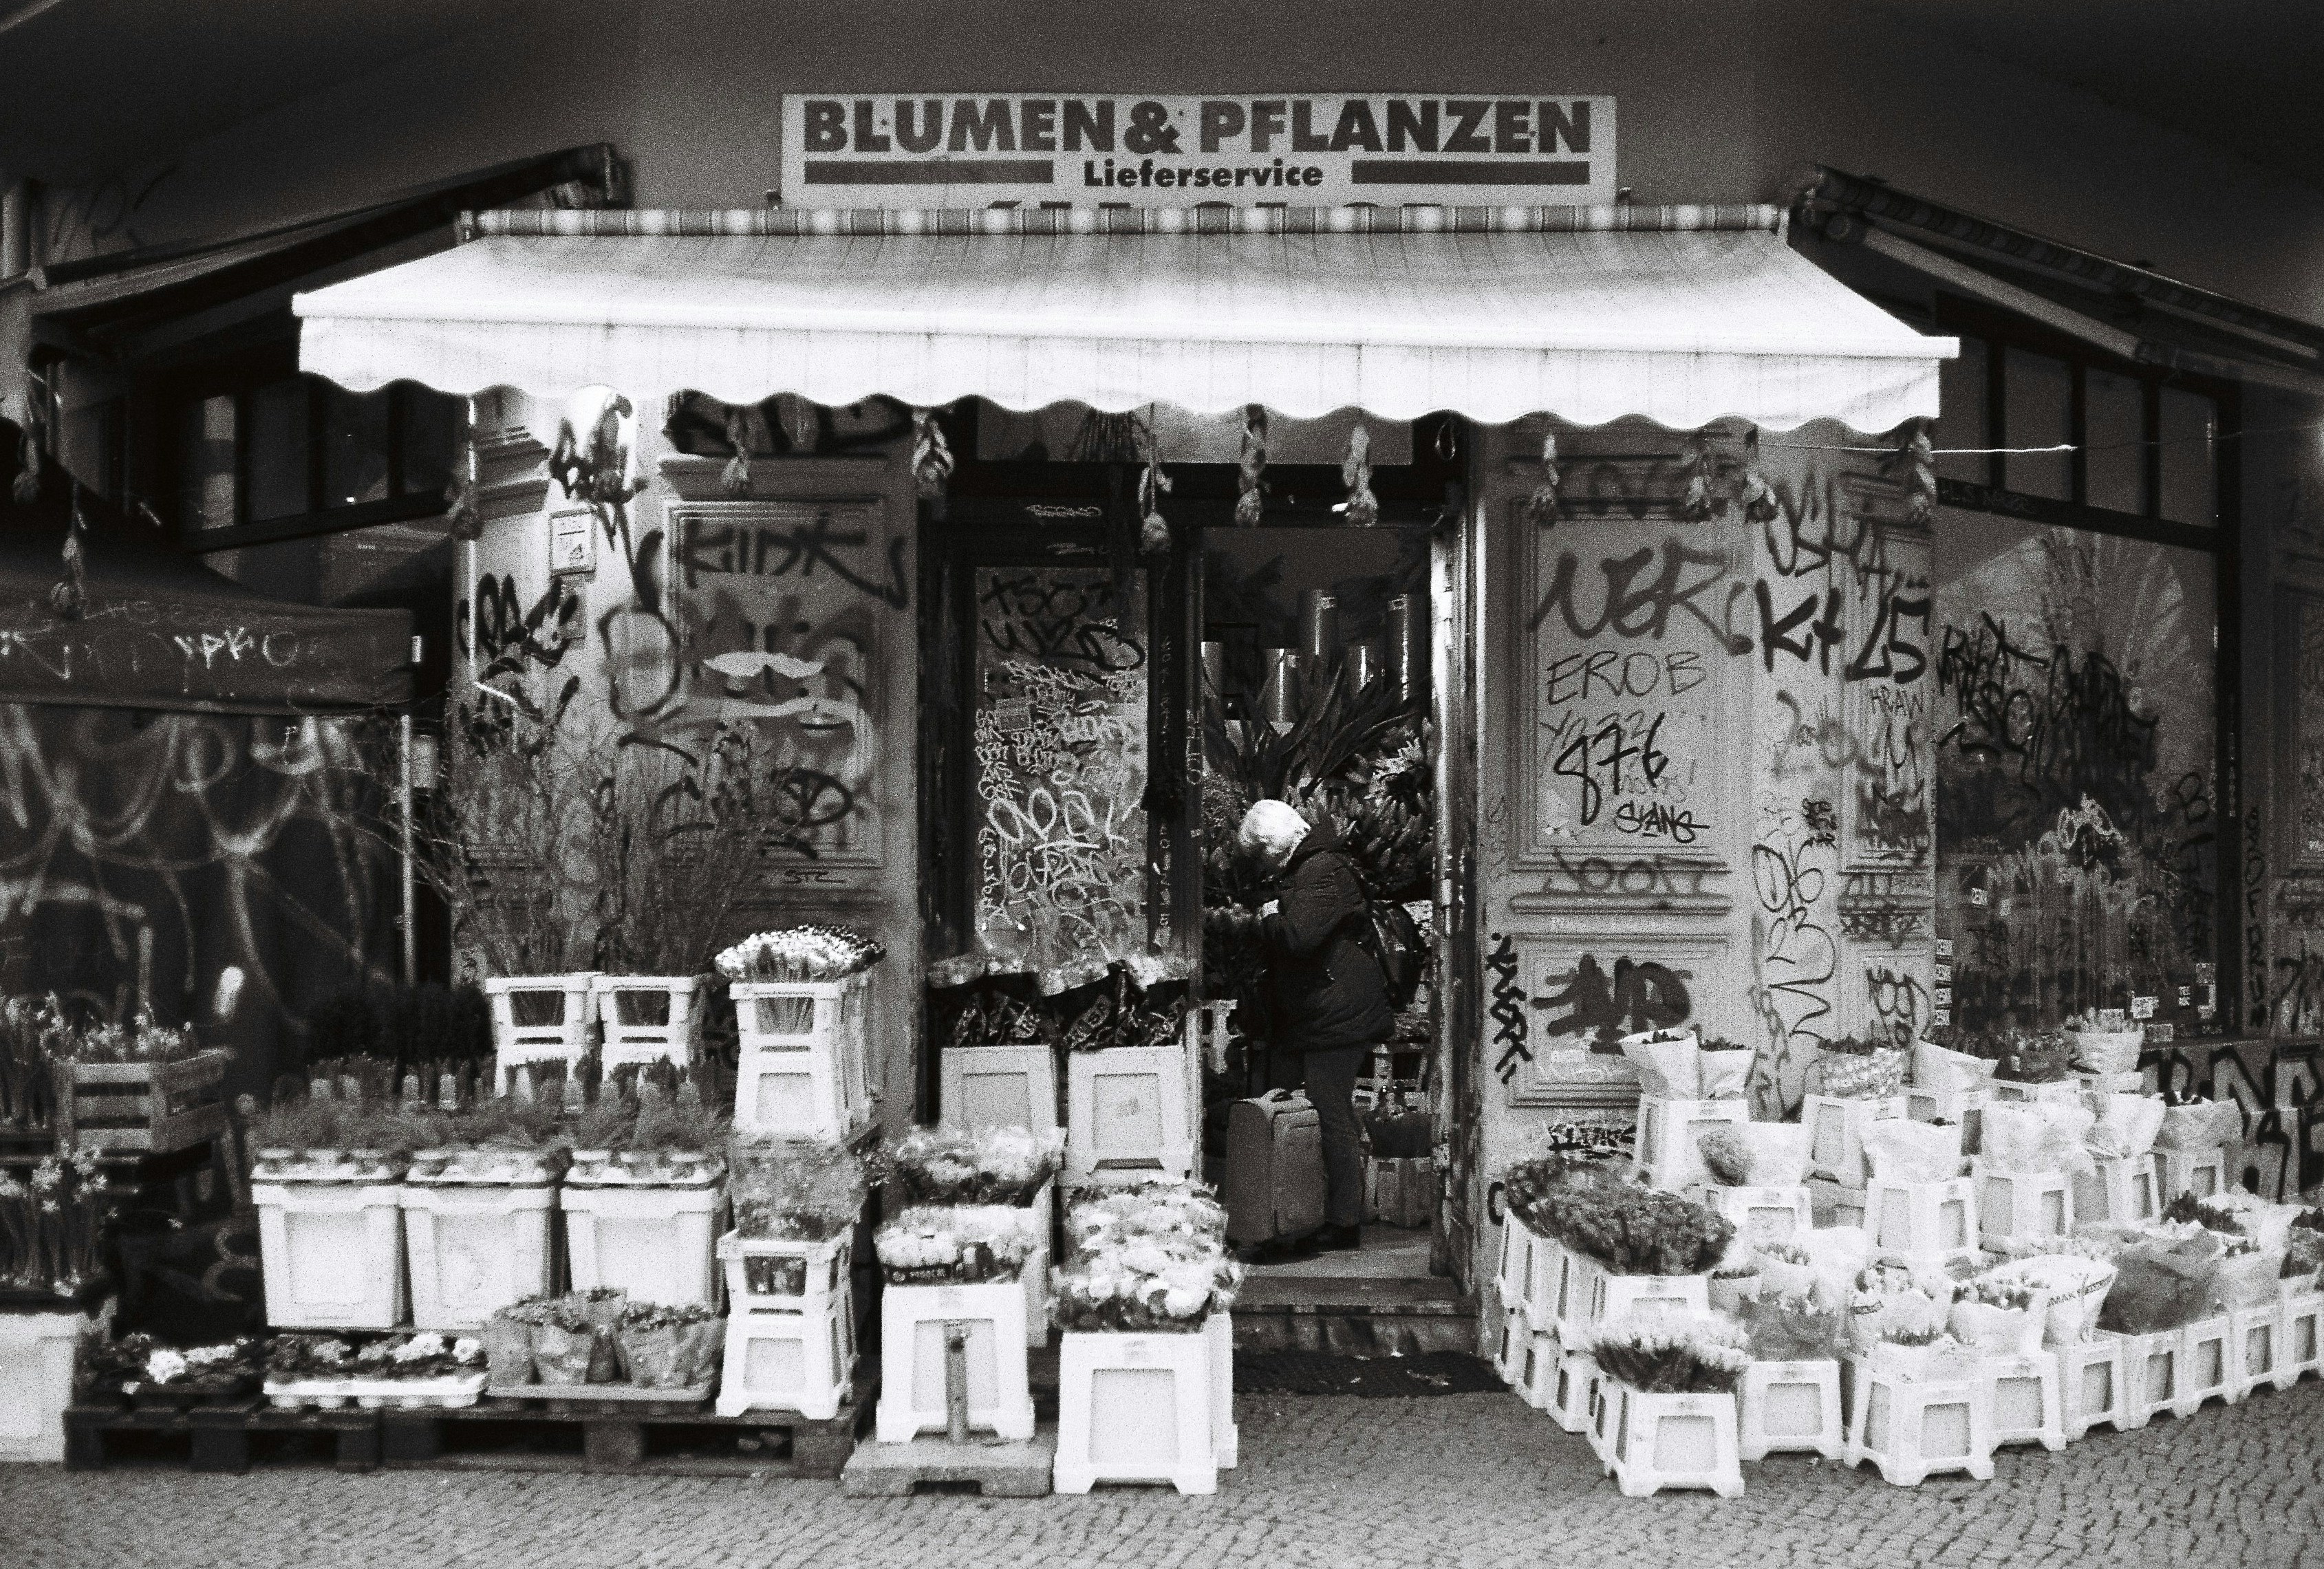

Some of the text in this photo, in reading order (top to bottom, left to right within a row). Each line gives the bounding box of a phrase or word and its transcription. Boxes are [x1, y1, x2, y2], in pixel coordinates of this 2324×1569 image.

[804, 100, 1115, 153] BLUMEN
[1200, 100, 1591, 153] PFLANZEN
[1084, 159, 1322, 188] Lieferservice
[1546, 649, 1709, 706] EROB
